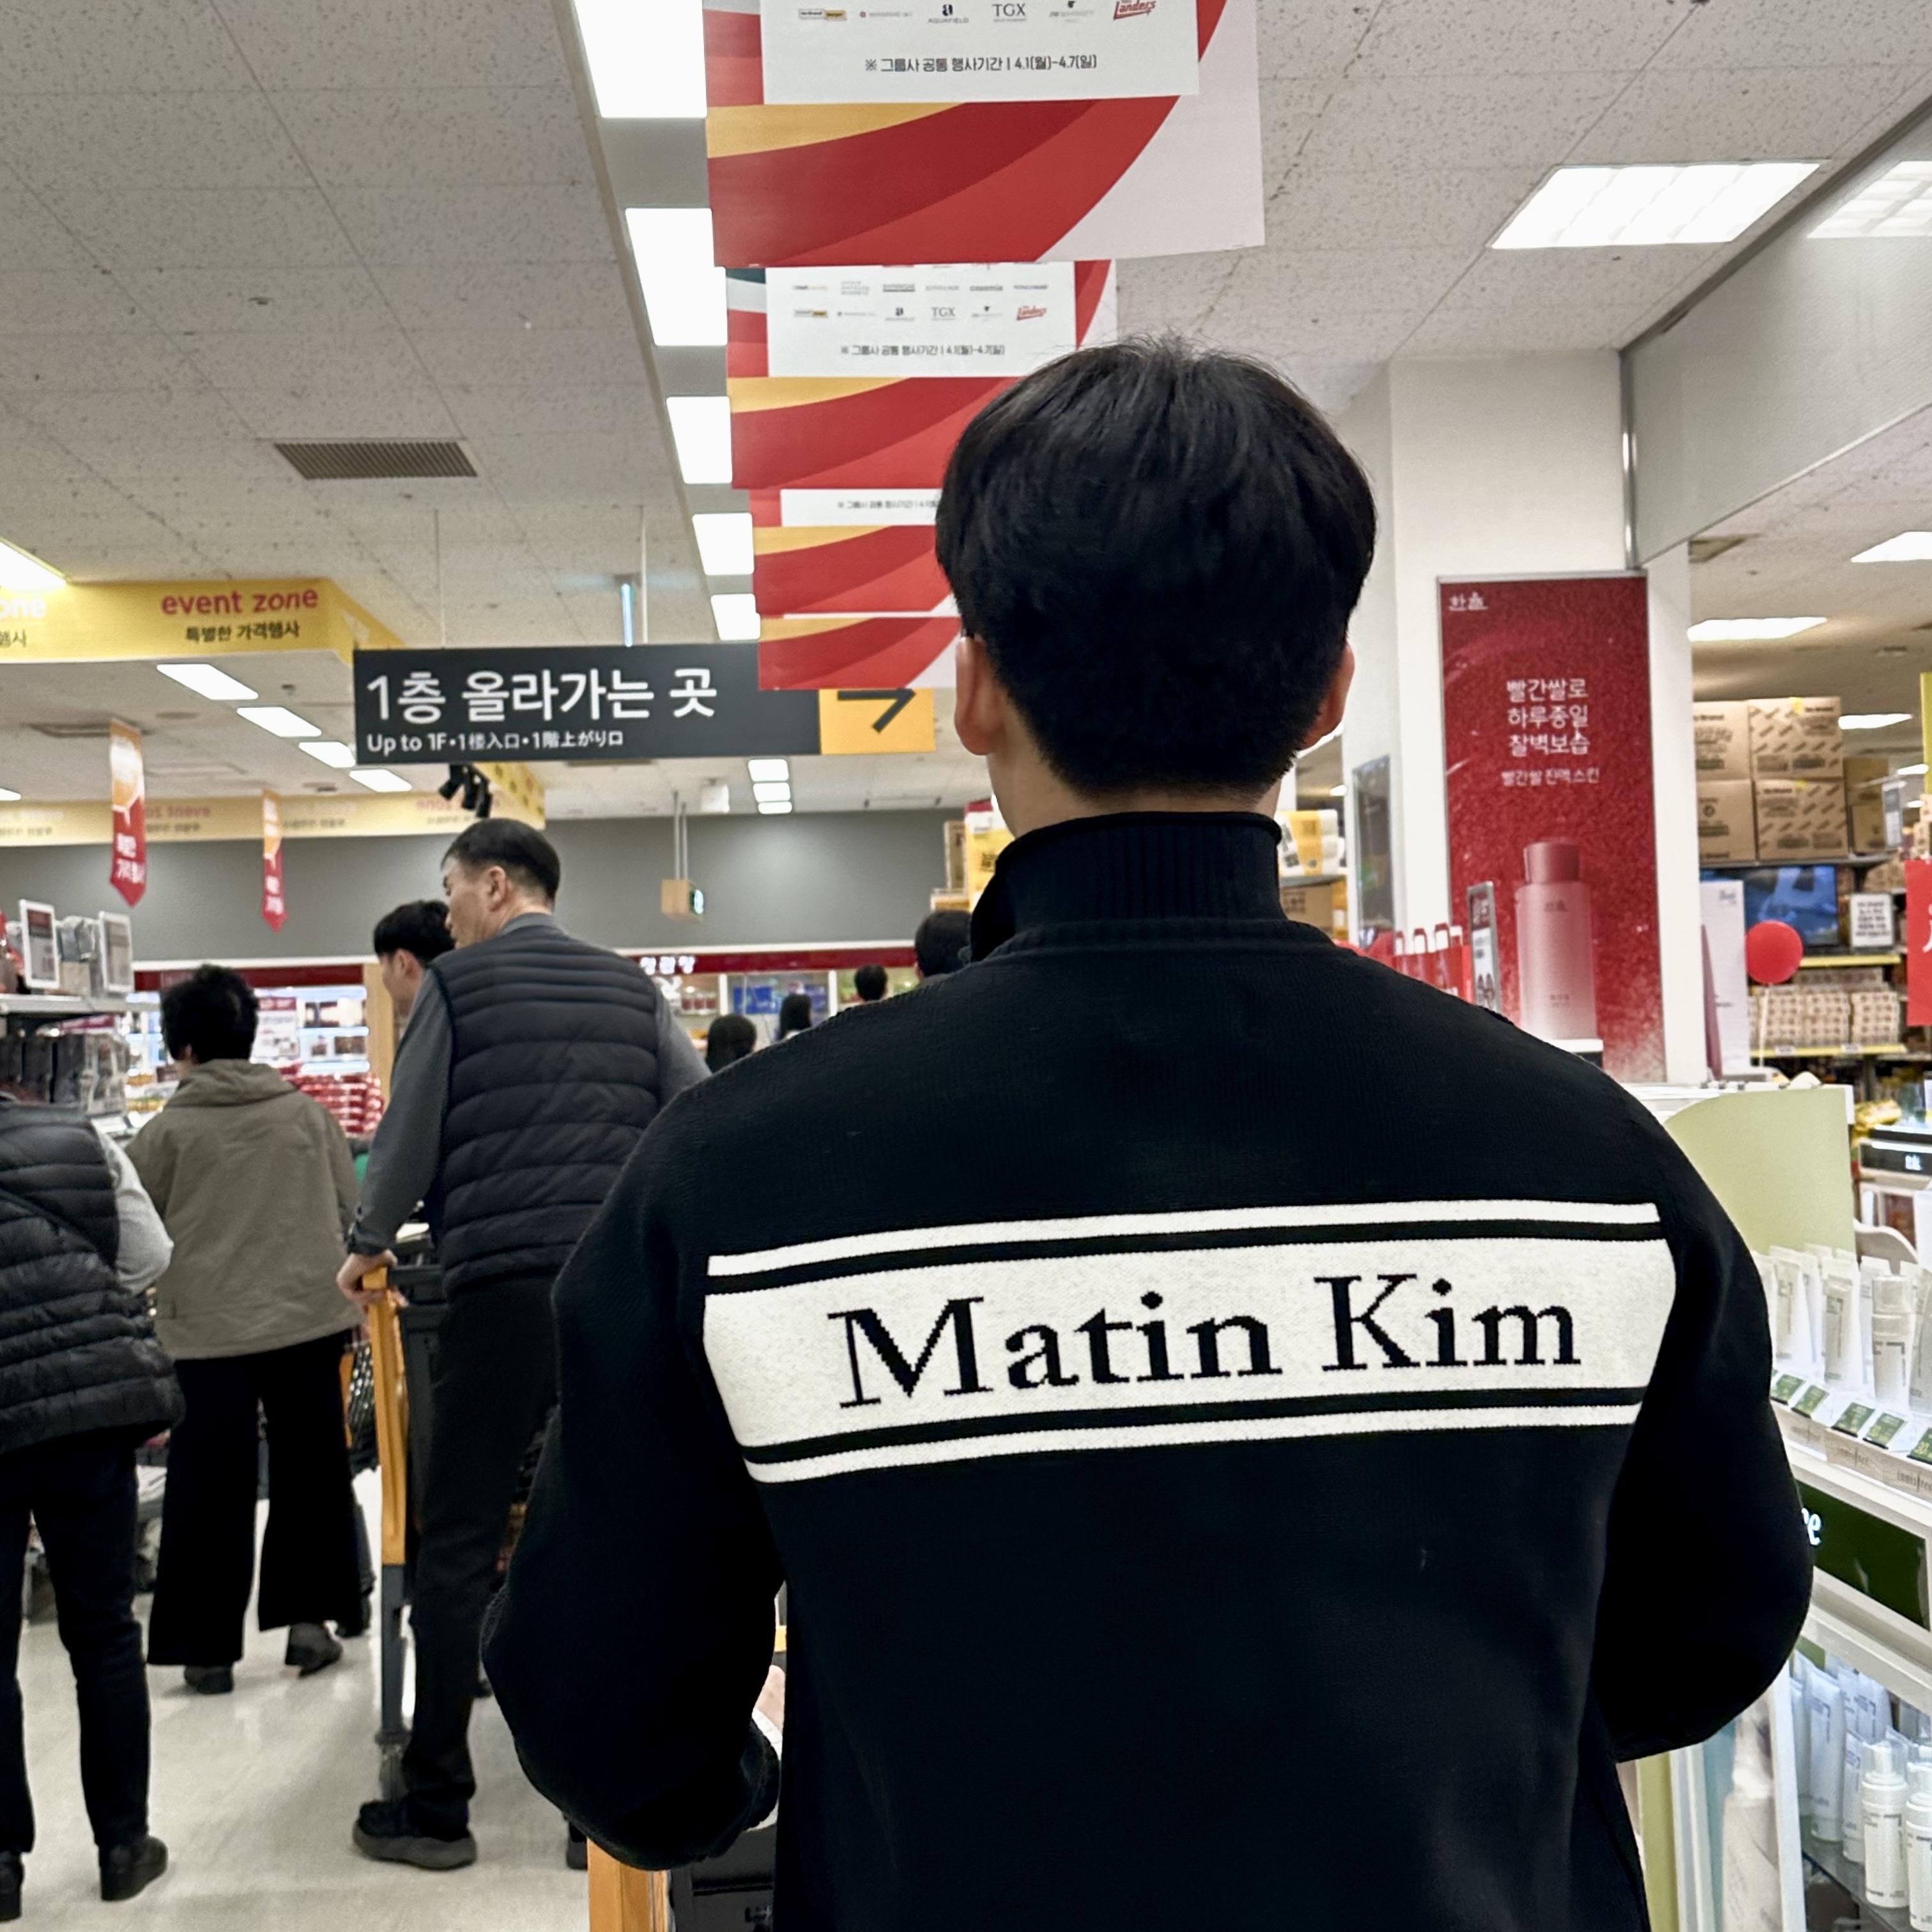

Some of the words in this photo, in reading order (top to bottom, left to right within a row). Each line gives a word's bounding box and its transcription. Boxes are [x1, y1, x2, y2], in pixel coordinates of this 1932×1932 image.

[992, 3, 1025, 17] TGX
[952, 57, 1002, 71] 행사기간
[931, 307, 955, 318] TGX
[162, 591, 241, 615] event
[252, 588, 319, 613] zone
[186, 625, 231, 644] 특별한
[367, 671, 446, 724] 1층
[461, 668, 654, 721] 올라가는
[669, 668, 717, 719] 곳
[1506, 678, 1589, 703] 빨간쌀로
[1507, 704, 1589, 729] 하루종일
[367, 734, 395, 756] Up
[401, 735, 422, 753] to
[1501, 770, 1542, 786] 빨간쌀
[827, 1291, 1283, 1409] Matin
[1312, 1273, 1582, 1372] Kim
